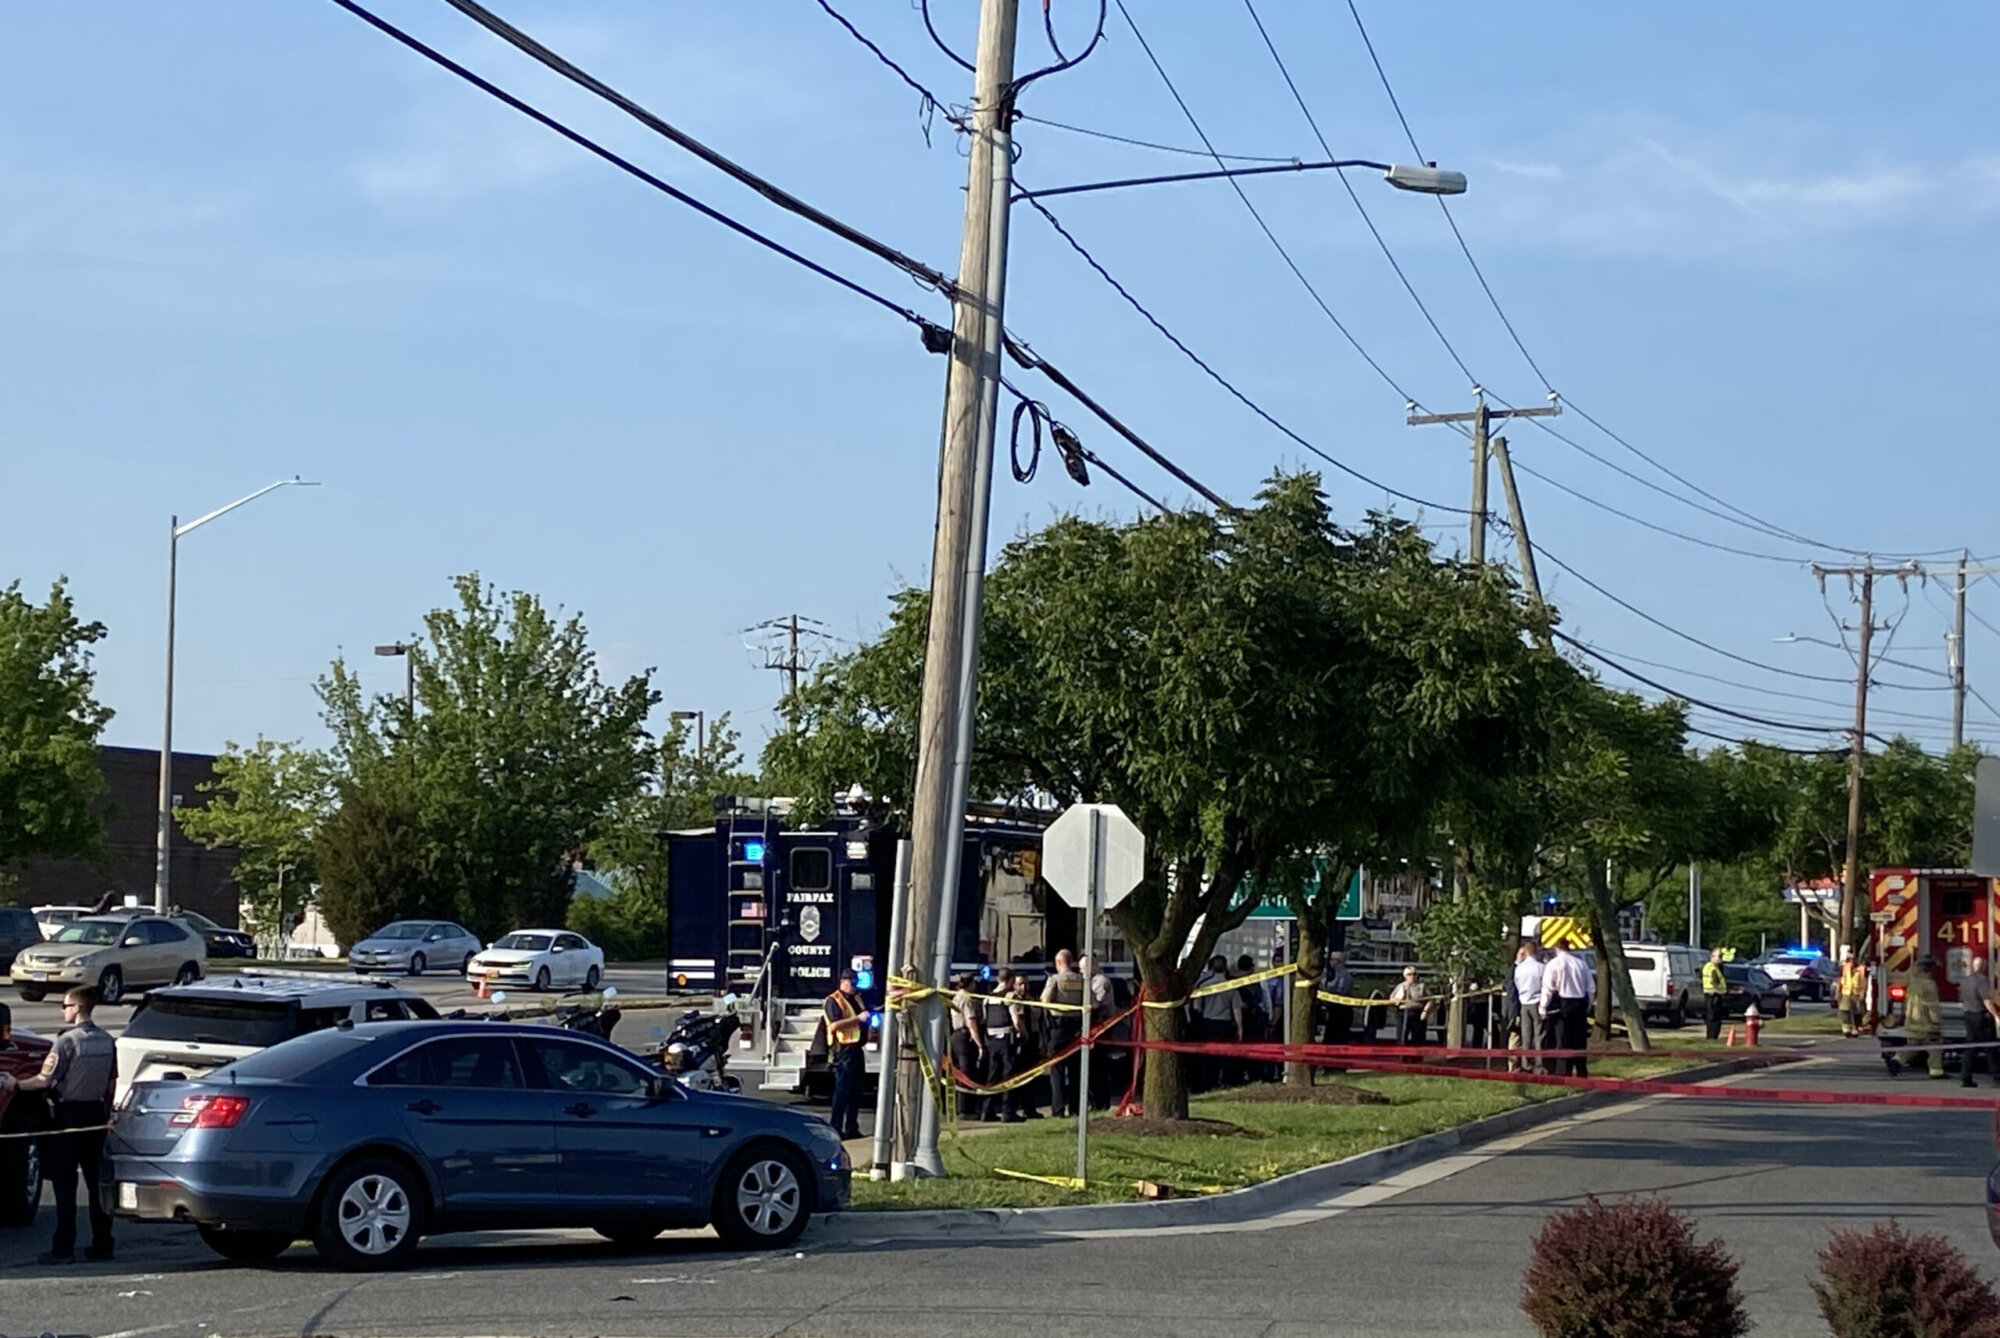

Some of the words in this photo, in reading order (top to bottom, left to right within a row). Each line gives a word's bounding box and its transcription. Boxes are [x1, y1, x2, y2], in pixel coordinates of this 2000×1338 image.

[786, 893, 834, 903] FAIRFAX
[1937, 921, 1984, 943] 411
[787, 945, 832, 955] COUNTY
[789, 966, 831, 978] POLICE
